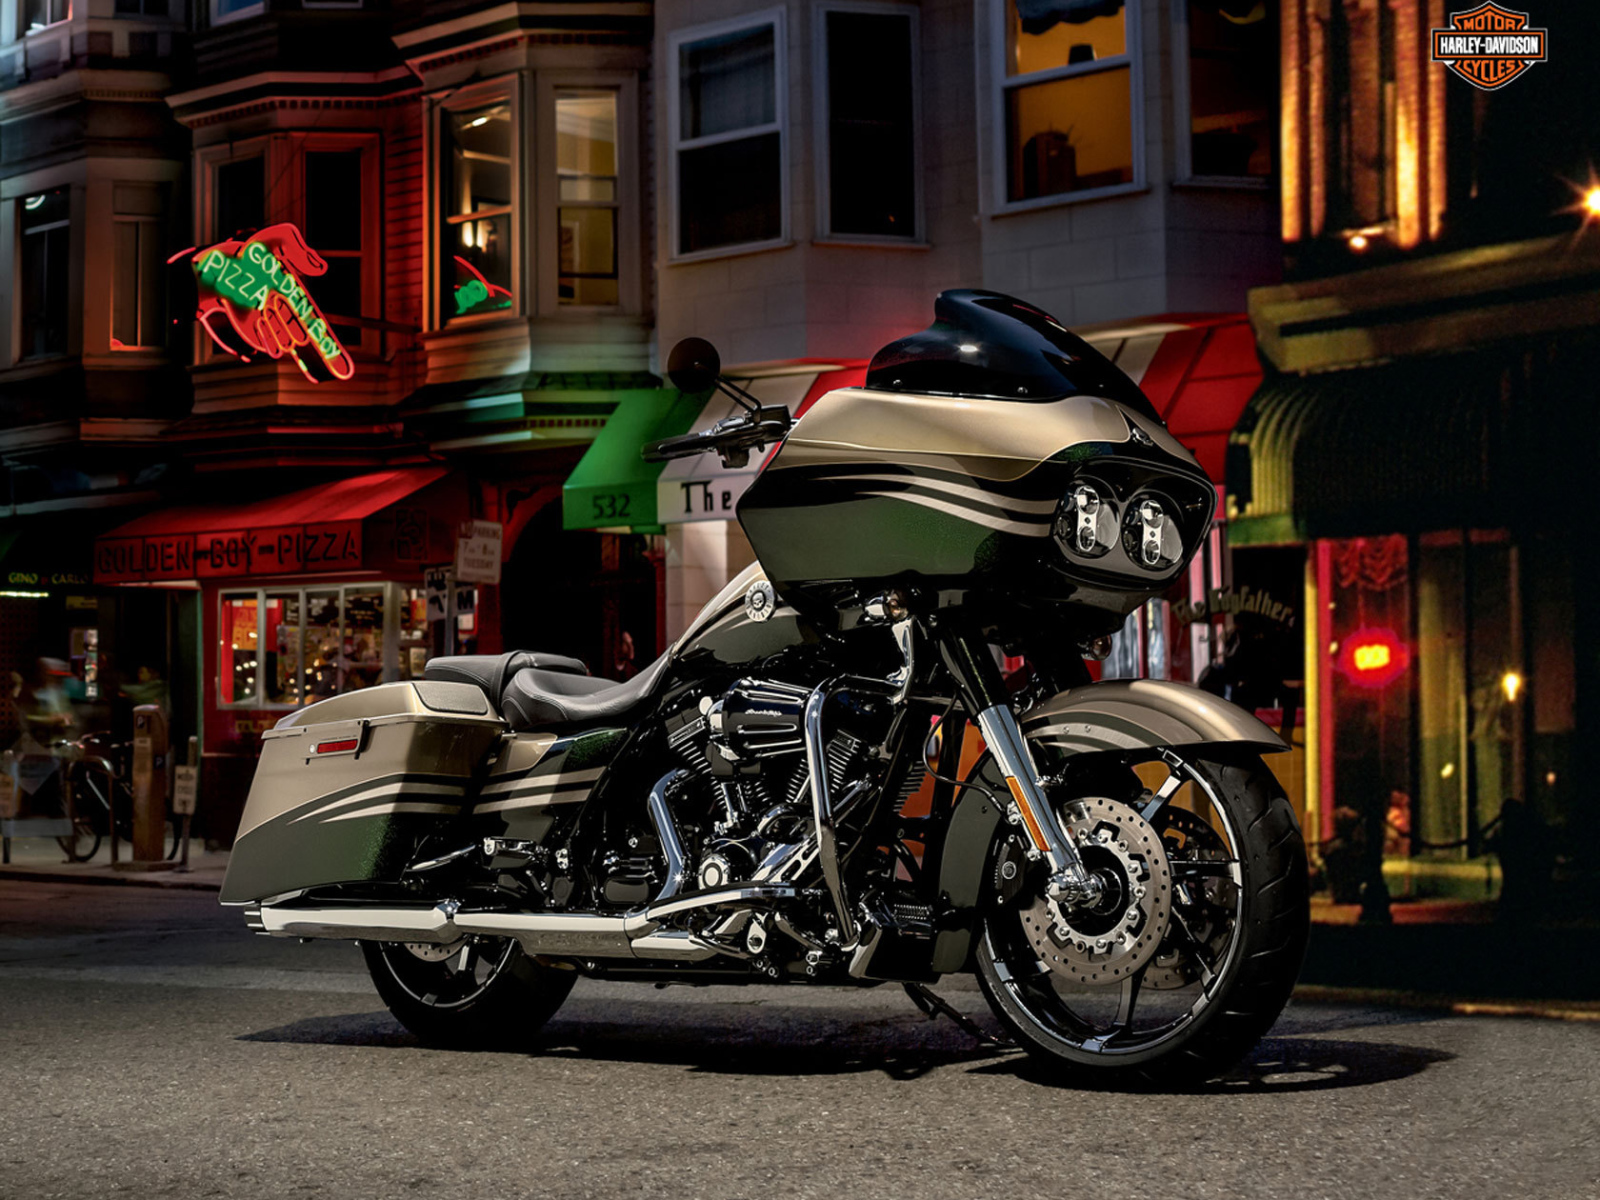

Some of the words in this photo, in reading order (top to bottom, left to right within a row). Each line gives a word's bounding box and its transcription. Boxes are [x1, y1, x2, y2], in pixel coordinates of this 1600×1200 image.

[203, 250, 270, 310] PIZZA
[248, 243, 313, 319] GOLDEN
[308, 319, 341, 359] BOY
[593, 493, 631, 519] 532
[681, 480, 732, 513] The
[8, 571, 39, 585] GINO
